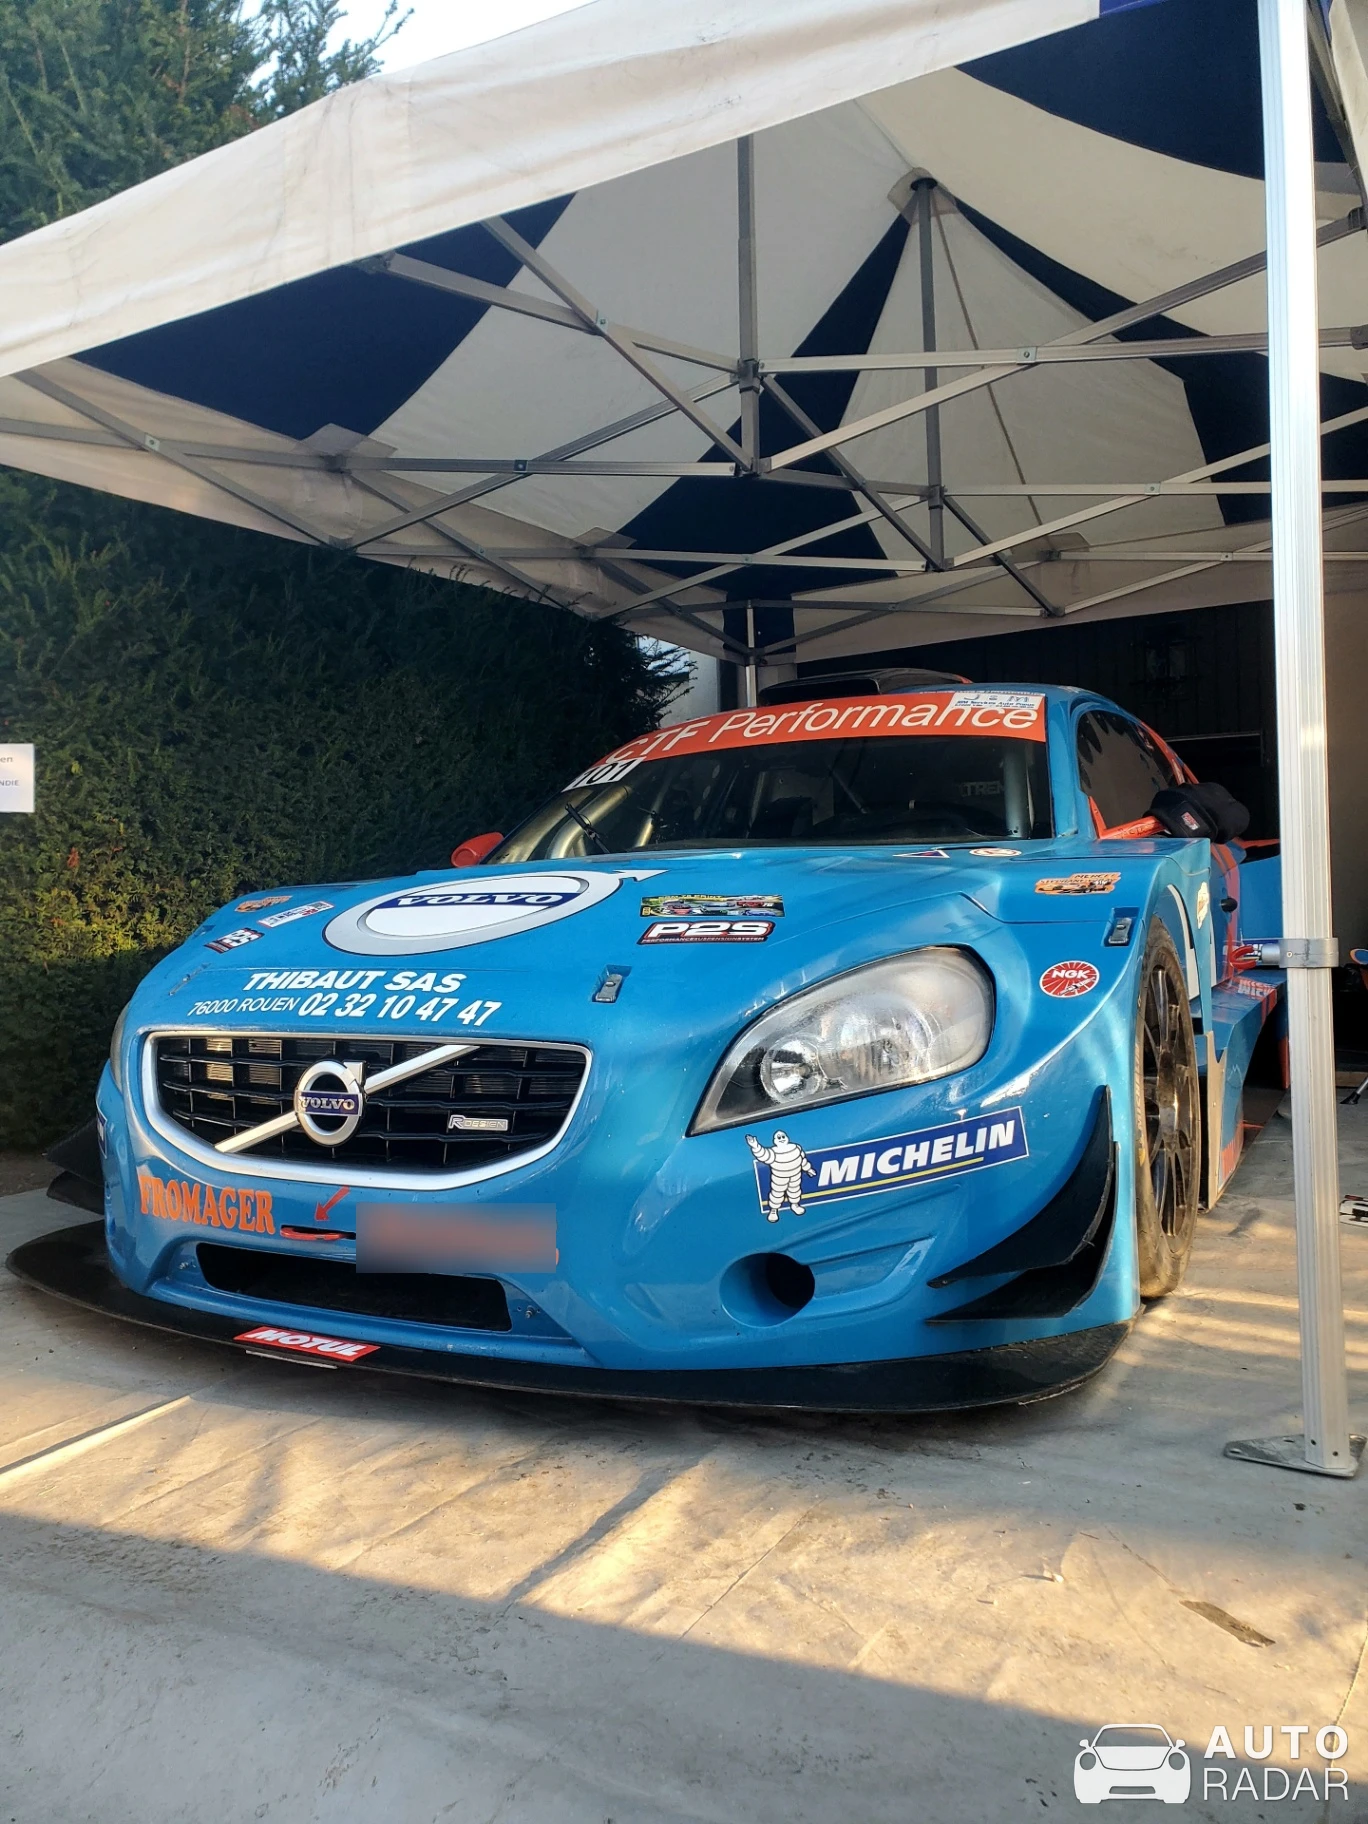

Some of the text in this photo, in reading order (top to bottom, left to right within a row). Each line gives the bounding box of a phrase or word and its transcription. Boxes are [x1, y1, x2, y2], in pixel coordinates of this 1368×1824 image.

[606, 702, 1038, 764] CTF Performance
[398, 893, 563, 907] VOLVO
[646, 921, 770, 938] P2S
[242, 970, 468, 993] THIBAUT SAS
[1051, 969, 1090, 979] NGK
[187, 992, 502, 1026] 76000 ROUEN 02 32 10 47 47
[299, 1095, 355, 1110] VOLVO
[817, 1119, 1016, 1187] MICHELIN
[138, 1173, 276, 1235] FROMAGER
[244, 1329, 367, 1357] MOTUL
